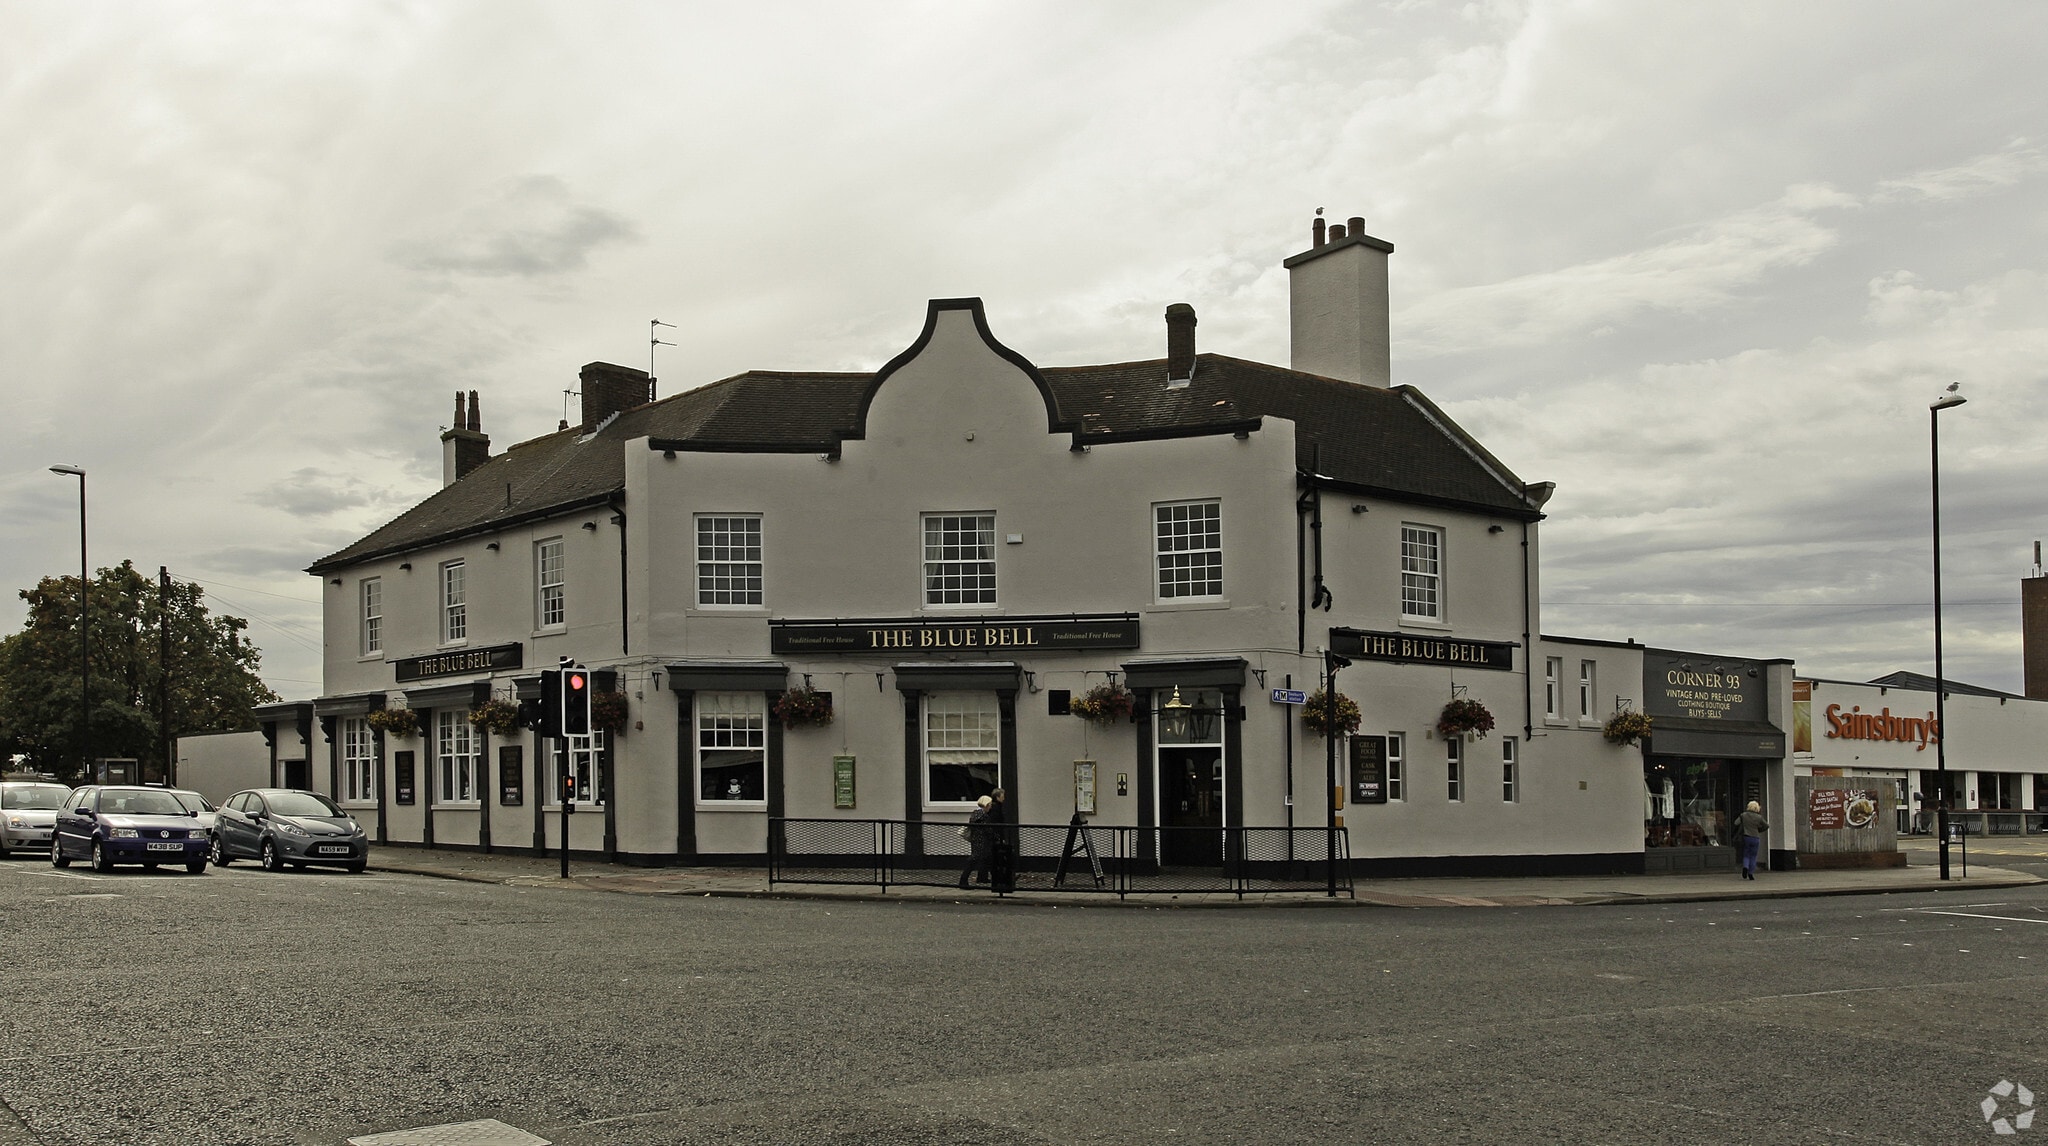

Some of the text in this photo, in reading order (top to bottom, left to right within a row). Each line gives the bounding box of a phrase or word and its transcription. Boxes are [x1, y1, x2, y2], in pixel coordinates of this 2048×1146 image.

[788, 636, 854, 645] Traditional Free House
[867, 627, 1039, 648] THE BLUE BELL
[1360, 636, 1489, 663] THE BLUE BELL
[418, 651, 493, 675] THE BLUE BELL
[1667, 670, 1740, 689] CORNER 93
[1665, 689, 1693, 699] VINTAGE
[1694, 691, 1709, 701] AND
[1677, 700, 1731, 711] CLOTHING BOUTIQUE
[1826, 703, 1939, 752] Sainsbury's
